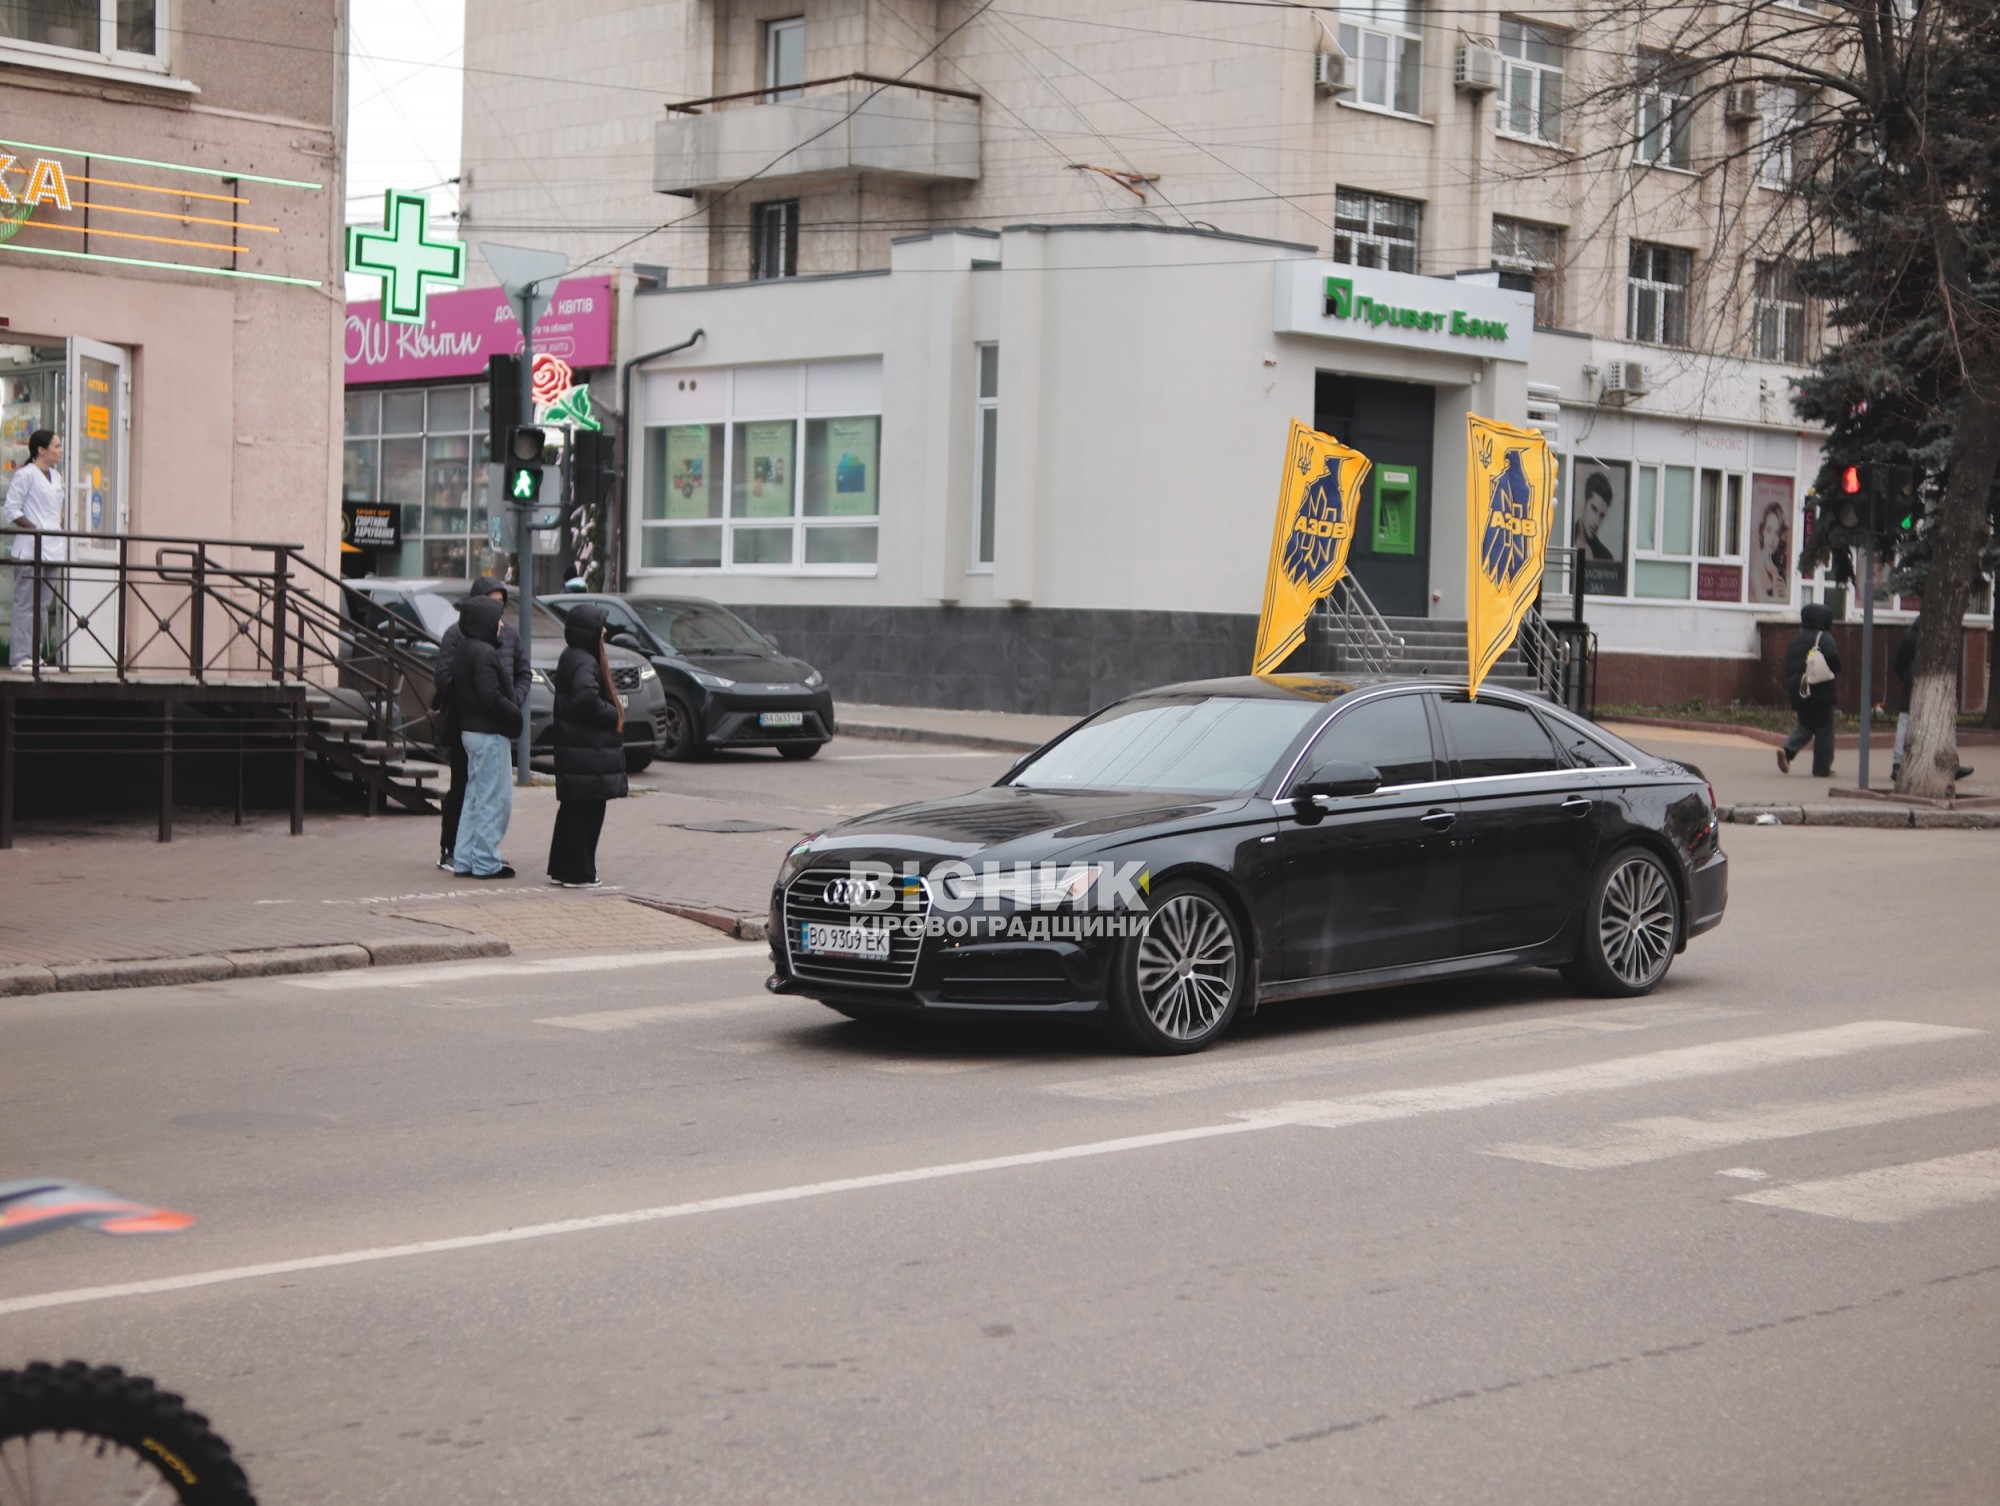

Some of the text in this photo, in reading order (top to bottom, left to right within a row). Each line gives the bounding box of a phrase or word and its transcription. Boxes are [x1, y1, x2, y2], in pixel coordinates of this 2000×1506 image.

[558, 297, 593, 316] КВІТІВ
[1355, 294, 1509, 341] Приват Банк
[1294, 515, 1348, 539] АЗОВ
[809, 926, 887, 952] BO 9309 EK
